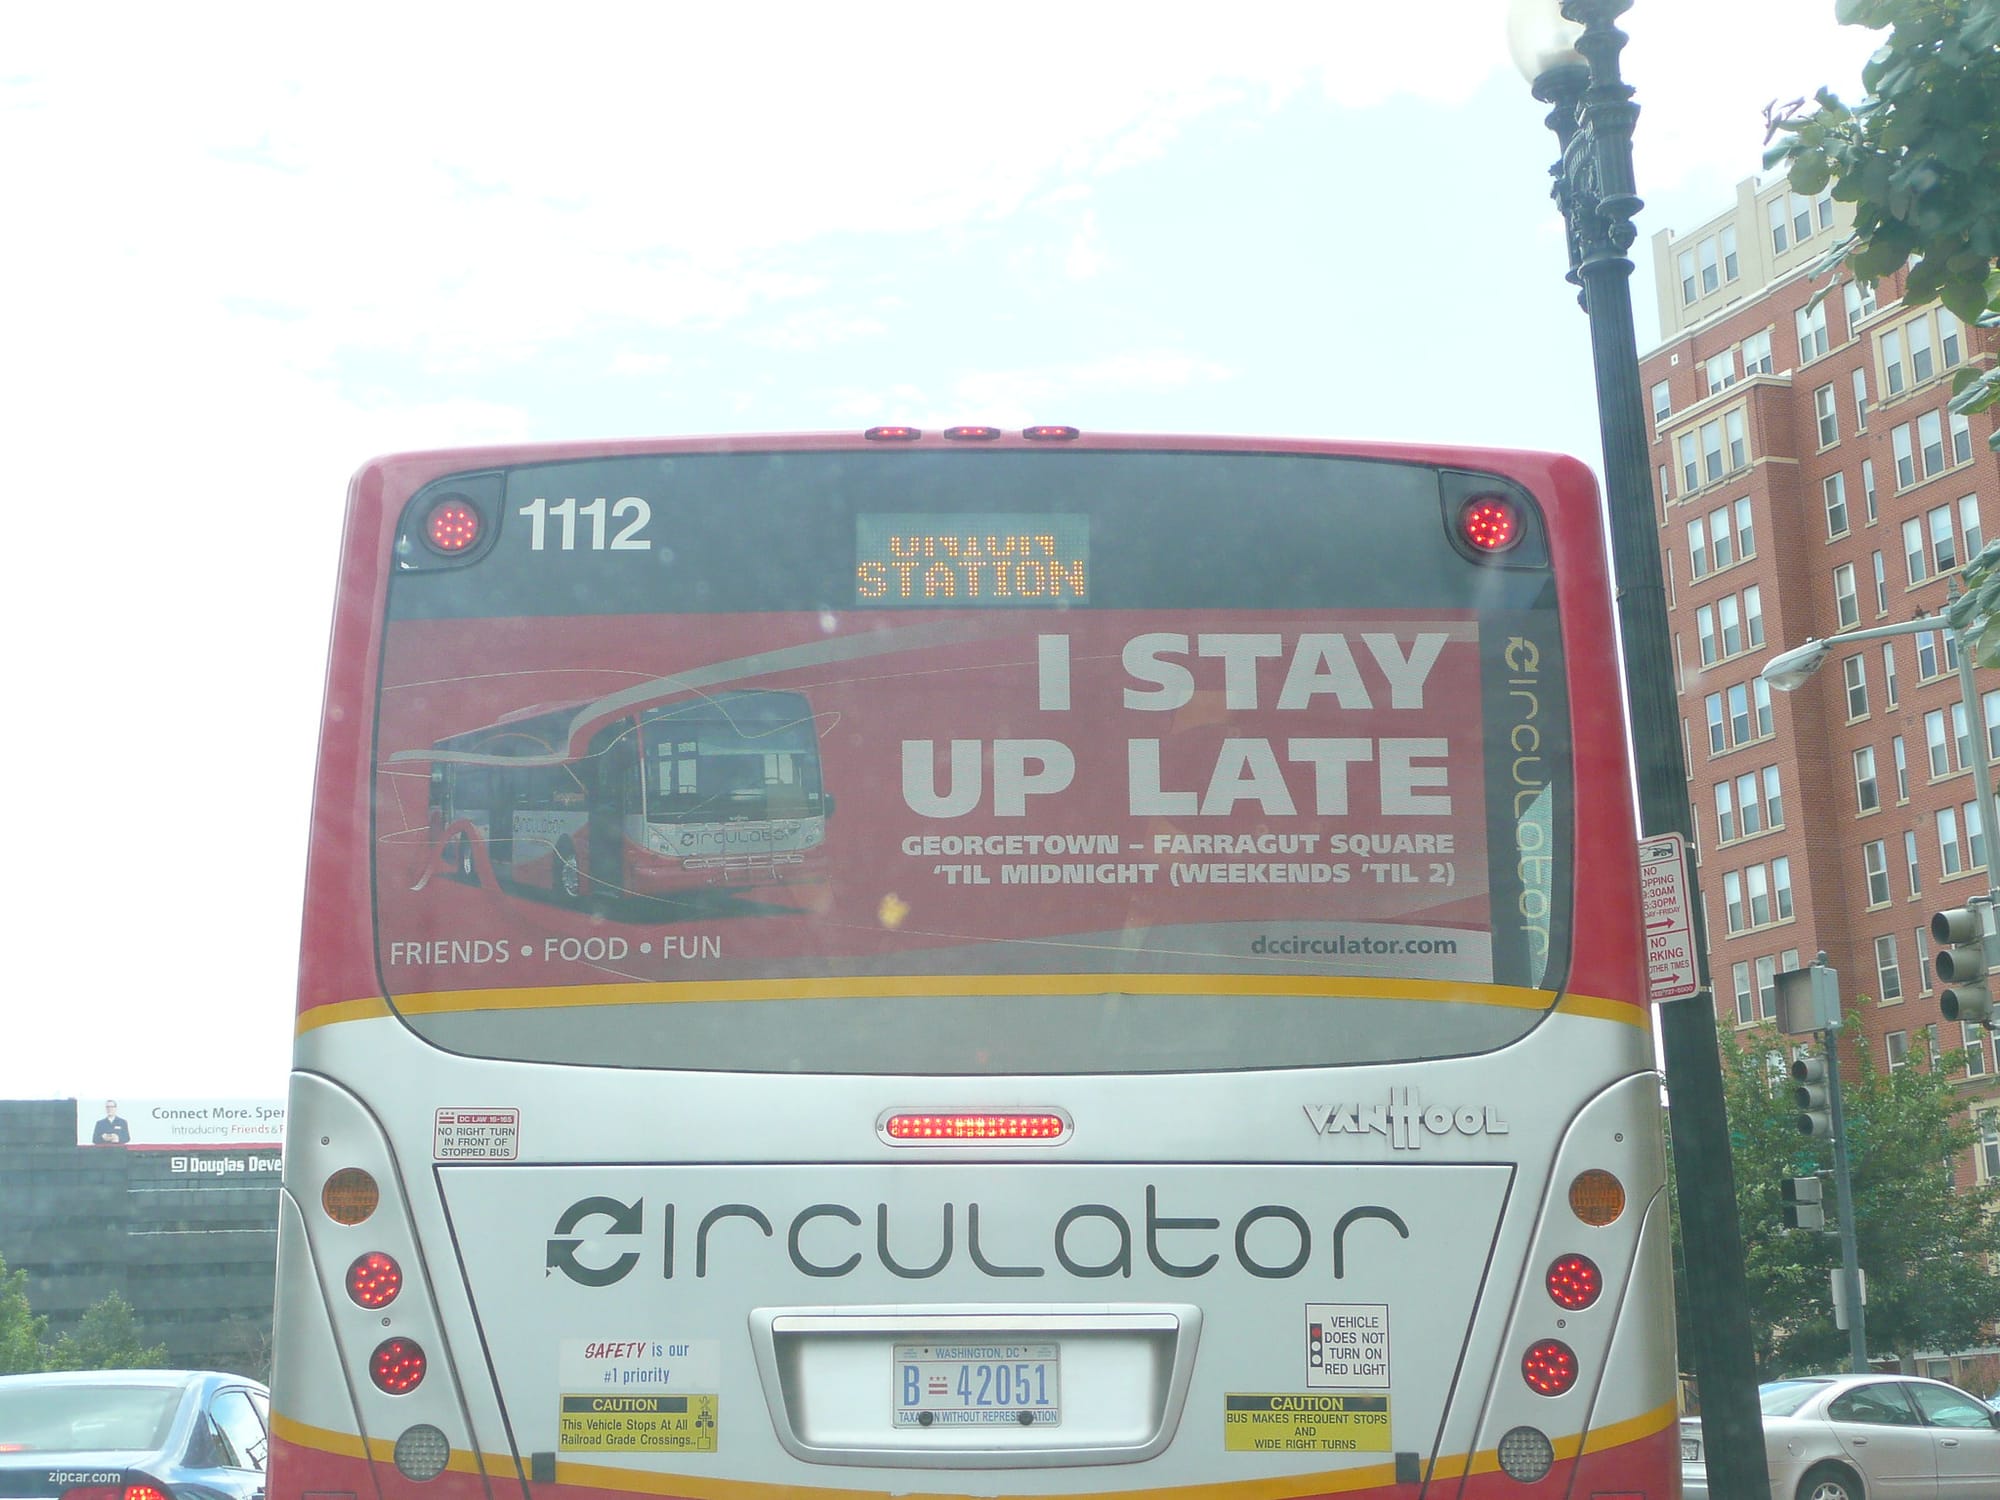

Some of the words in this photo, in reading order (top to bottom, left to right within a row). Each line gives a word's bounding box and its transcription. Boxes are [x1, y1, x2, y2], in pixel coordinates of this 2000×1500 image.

[520, 496, 652, 551] 1112
[858, 560, 1085, 598] STATION
[1038, 634, 1071, 711] I
[1121, 632, 1451, 712] STAY
[902, 738, 1076, 818] UP
[1127, 737, 1453, 817] LATE
[902, 834, 1120, 856] GEORGETOWN
[1153, 833, 1320, 856] FARRAGUT
[1330, 833, 1455, 856] SQUARE
[1000, 863, 1159, 885] MIDNIGHT
[1169, 861, 1352, 887] (WEEKENDS
[1428, 862, 1457, 886] 2)
[1643, 866, 1657, 878] NO
[1641, 874, 1675, 889] OPPING
[1643, 898, 1677, 912] 6:30PM
[1251, 934, 1457, 956] dccirculator.com
[1650, 936, 1667, 950] NO
[389, 939, 510, 966] FRIENDS
[544, 937, 629, 962] FOOD
[663, 935, 722, 960] FUN
[1650, 946, 1684, 962] RKING
[1670, 959, 1690, 972] TIMES
[152, 1107, 209, 1119] Connect
[212, 1107, 251, 1119] More.
[171, 1124, 229, 1137] Introducing
[231, 1124, 270, 1135] Friends
[438, 1127, 453, 1136] NO
[456, 1127, 485, 1136] RIGHT
[489, 1127, 516, 1136] TURN
[444, 1138, 454, 1146] IN
[458, 1138, 490, 1146] FRONT
[494, 1138, 508, 1146] OF
[441, 1148, 486, 1157] STOPPED
[489, 1148, 510, 1157] BUS
[190, 1157, 245, 1176] Douglas
[248, 1156, 283, 1172] Deve
[1330, 1316, 1379, 1328] VEHICLE
[1324, 1332, 1357, 1344] DOES
[1361, 1332, 1385, 1344] NOT
[584, 1342, 647, 1359] SAFETY
[651, 1342, 663, 1357] is
[668, 1343, 690, 1357] our
[935, 1347, 1004, 1360] WASHINGTON,
[1006, 1347, 1020, 1358] DC
[1328, 1347, 1360, 1360] TURN
[1364, 1348, 1382, 1360] ON
[604, 1367, 618, 1384] #1
[623, 1367, 671, 1386] priority
[1324, 1364, 1348, 1375] RED
[1353, 1363, 1387, 1376] LIGHT
[903, 1365, 921, 1406] B
[956, 1364, 1050, 1406] 42051
[592, 1398, 658, 1412] CAUTION
[1270, 1397, 1344, 1411] CAUTION
[942, 1411, 982, 1423] WITHOUT
[1226, 1413, 1248, 1424] BUS
[1252, 1414, 1289, 1424] MAKES
[1293, 1414, 1349, 1424] FREQUENT
[1354, 1414, 1388, 1425] STOPS
[562, 1418, 583, 1431] This
[587, 1418, 623, 1431] Vehicle
[626, 1418, 657, 1433] Stops
[660, 1418, 672, 1431] At
[675, 1418, 689, 1431] All
[1294, 1426, 1317, 1437] AND
[561, 1433, 602, 1446] Railroad
[606, 1434, 637, 1446] Grade
[1254, 1439, 1282, 1449] WIDE
[1285, 1439, 1317, 1449] RIGHT
[1321, 1439, 1357, 1450] TURNS
[48, 1469, 121, 1485] zipcar.com
